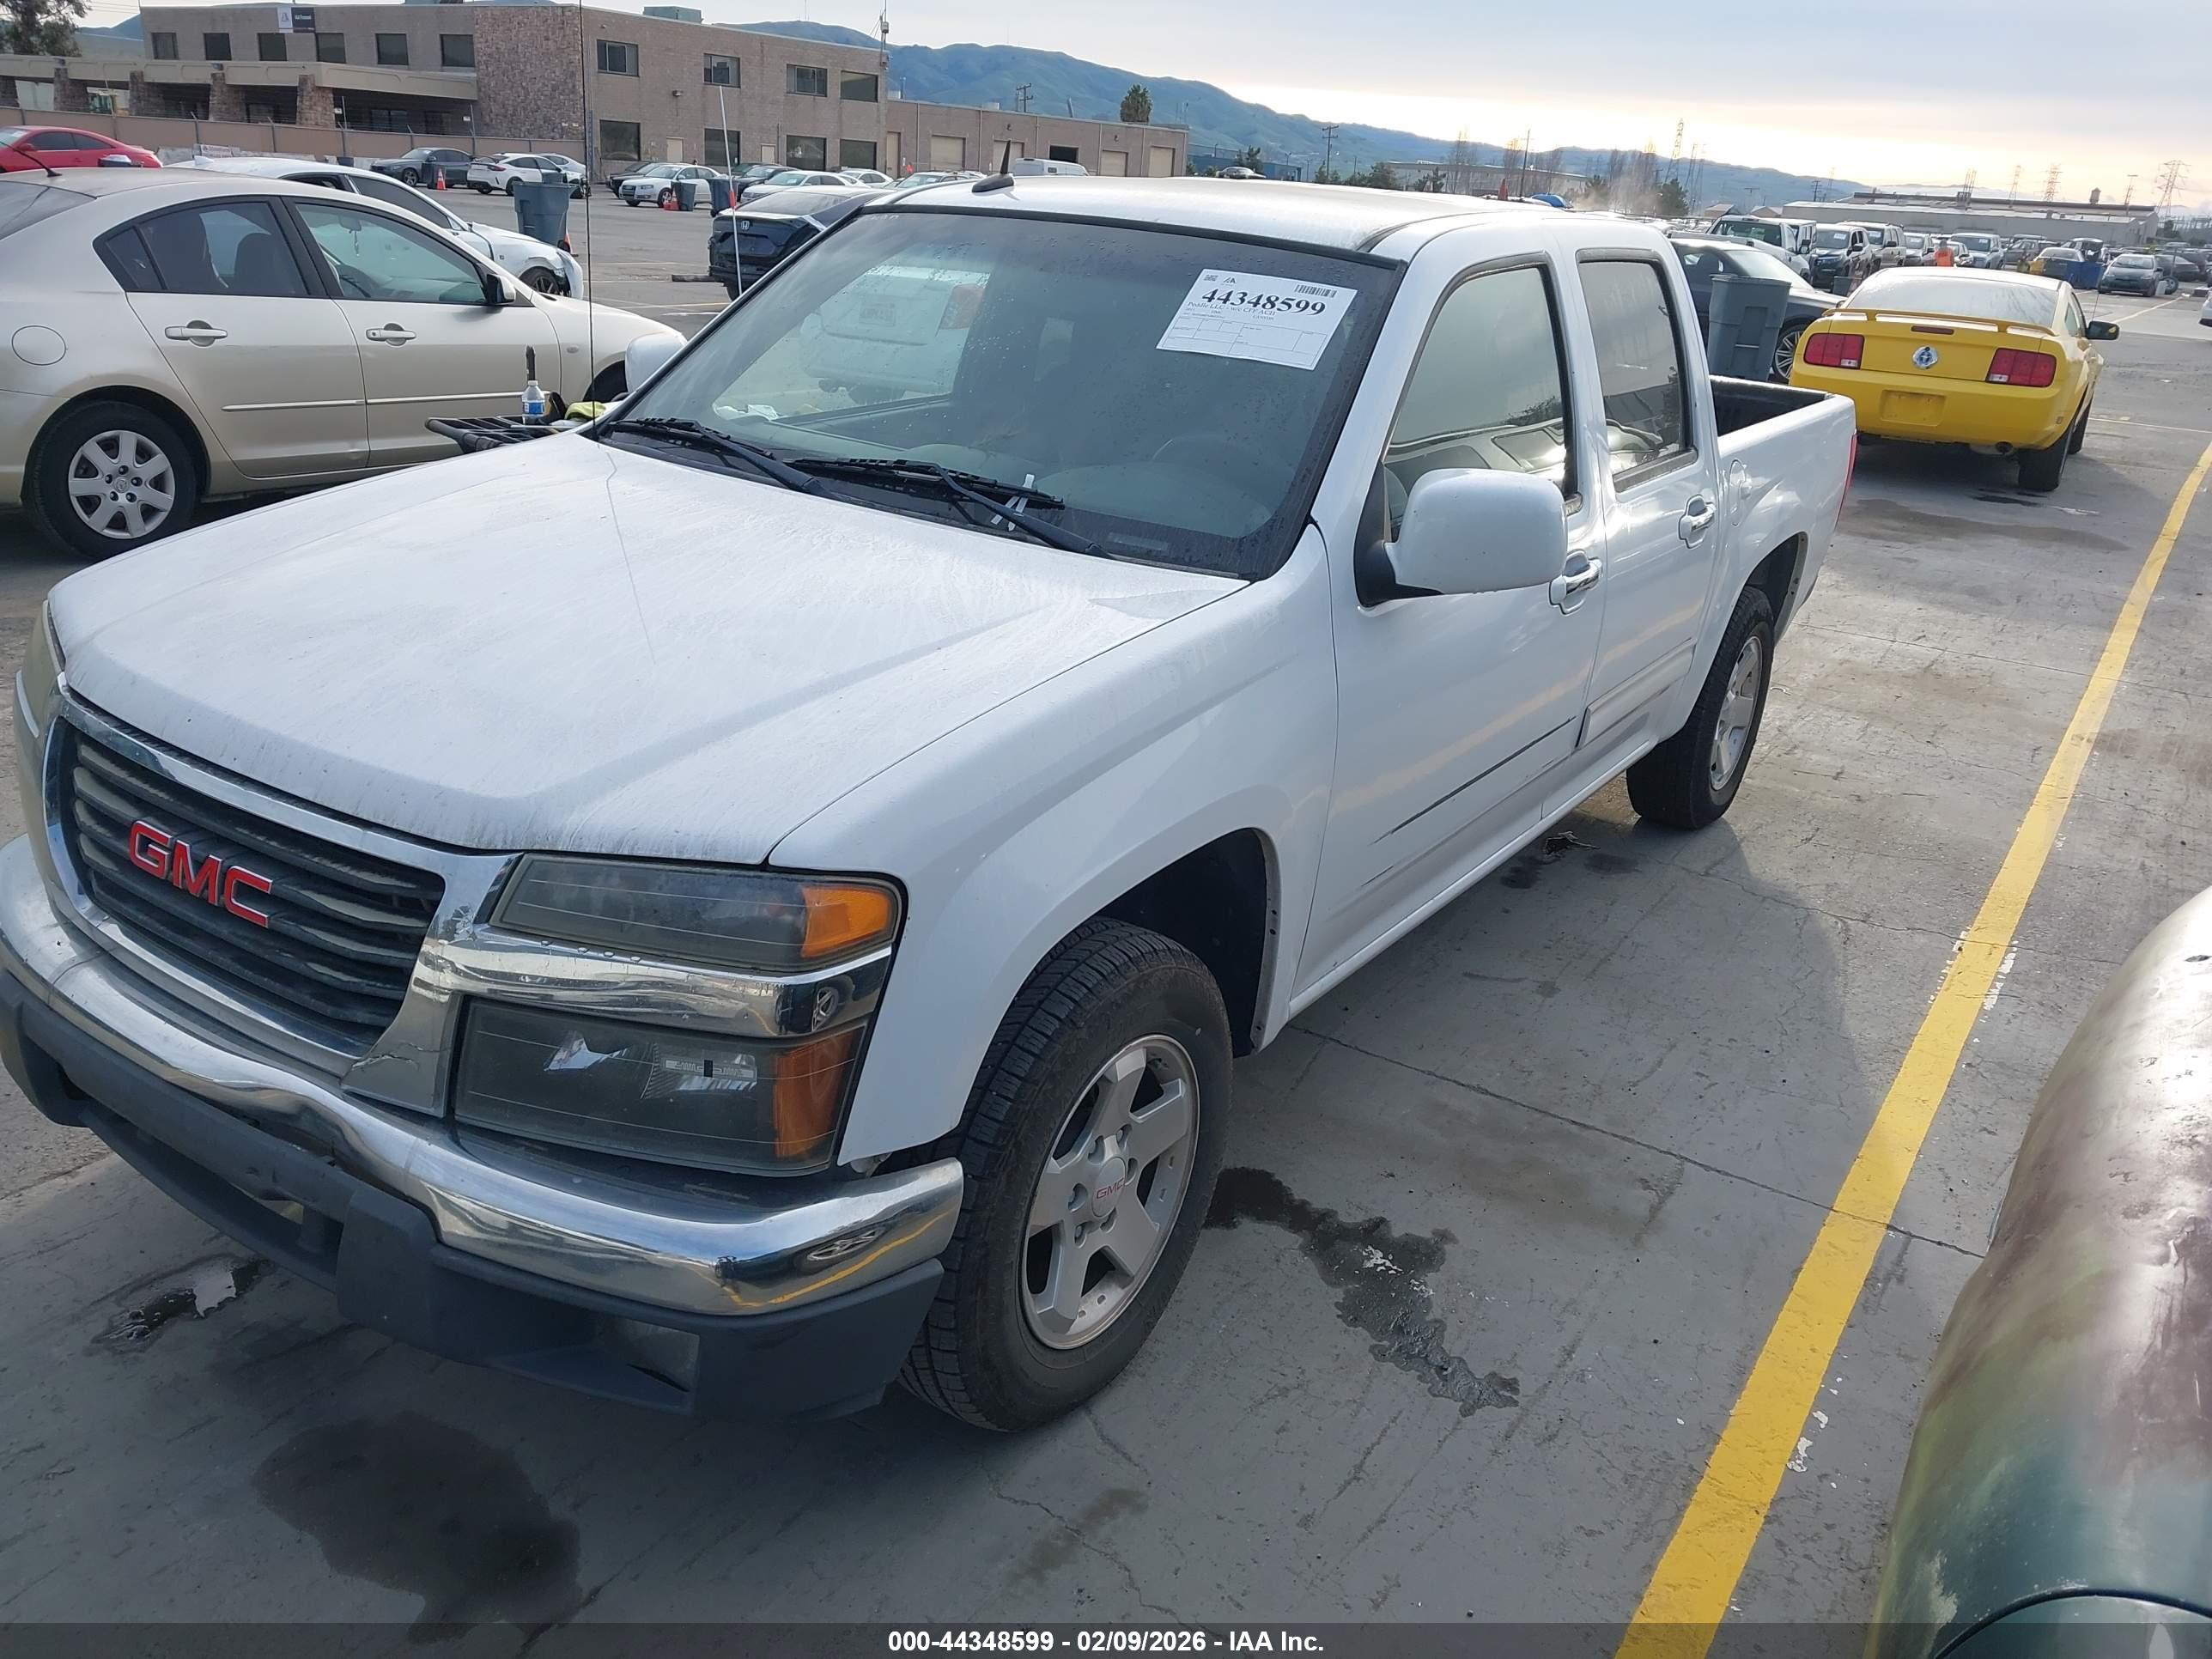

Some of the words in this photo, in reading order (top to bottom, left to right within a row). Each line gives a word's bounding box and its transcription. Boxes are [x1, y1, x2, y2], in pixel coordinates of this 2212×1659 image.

[1201, 288, 1326, 316] 44348599
[130, 820, 273, 928] GMC
[1096, 1177, 1126, 1199] GMC
